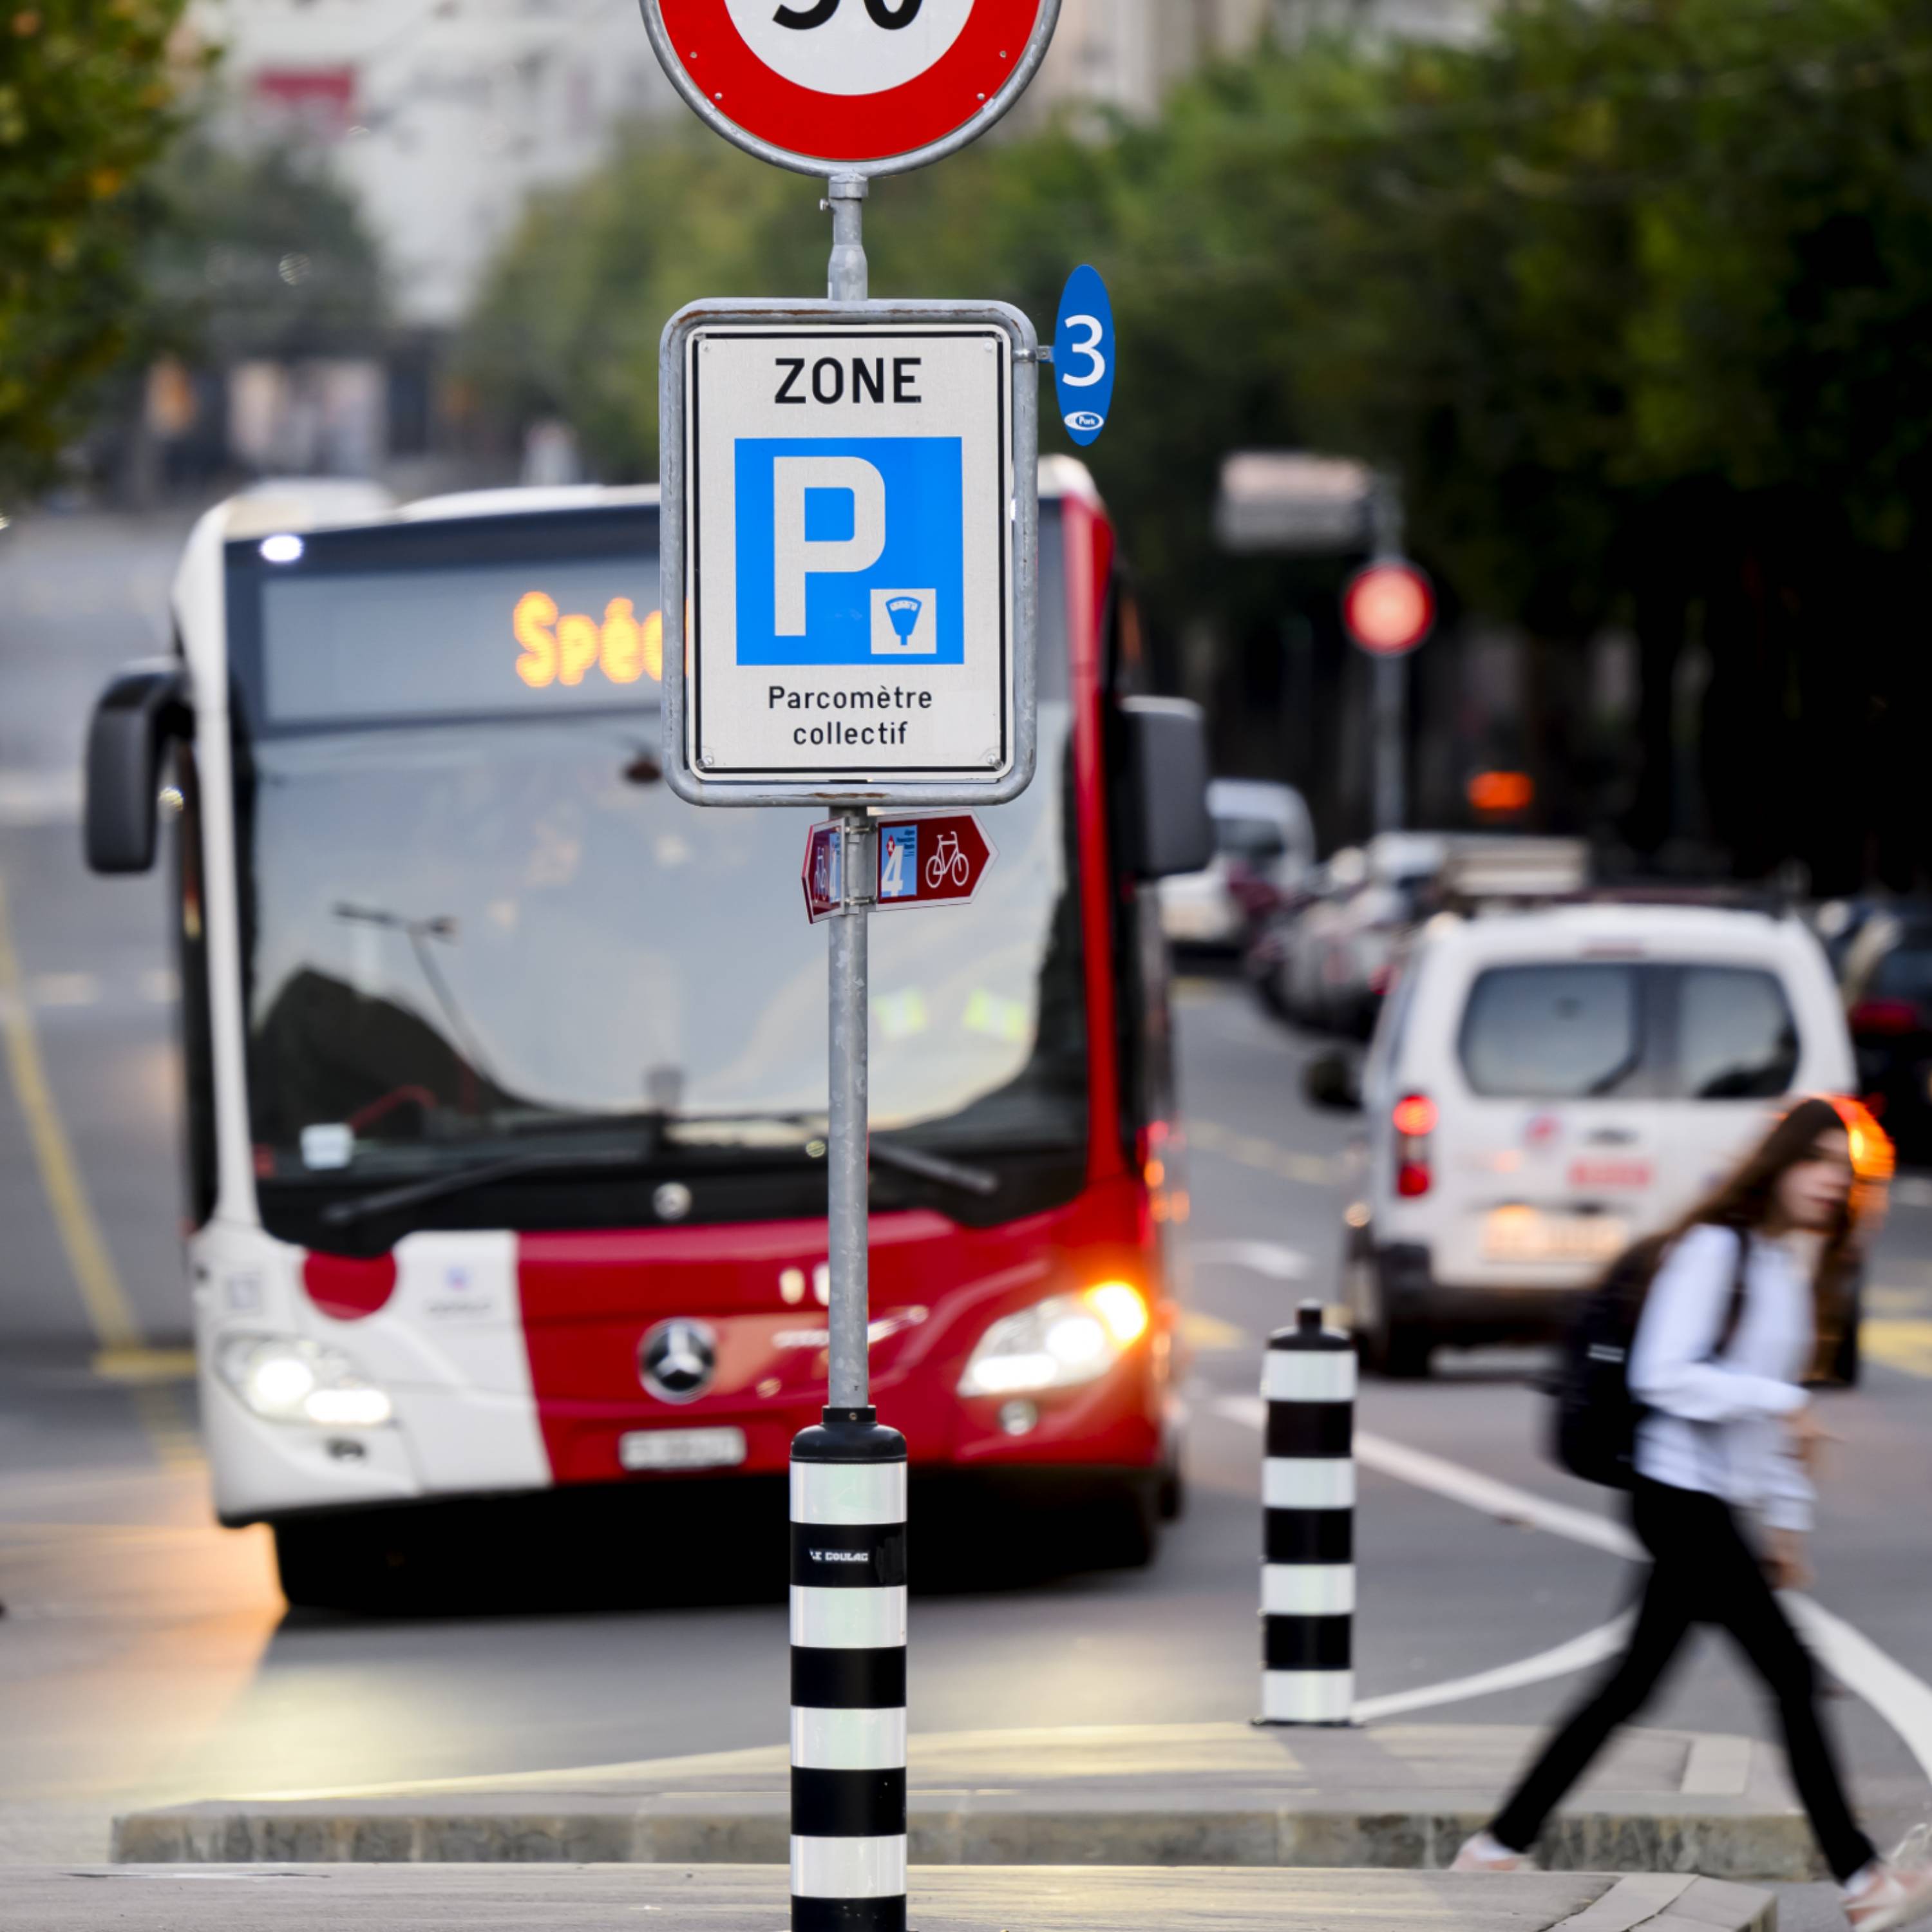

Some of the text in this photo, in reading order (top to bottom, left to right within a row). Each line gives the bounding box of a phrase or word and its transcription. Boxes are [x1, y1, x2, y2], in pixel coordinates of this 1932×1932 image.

[1063, 314, 1105, 386] 3
[775, 357, 922, 404] ZONE
[773, 456, 886, 636] P
[769, 686, 932, 709] Parcomètre
[793, 721, 907, 744] collectif
[881, 845, 903, 896] 4
